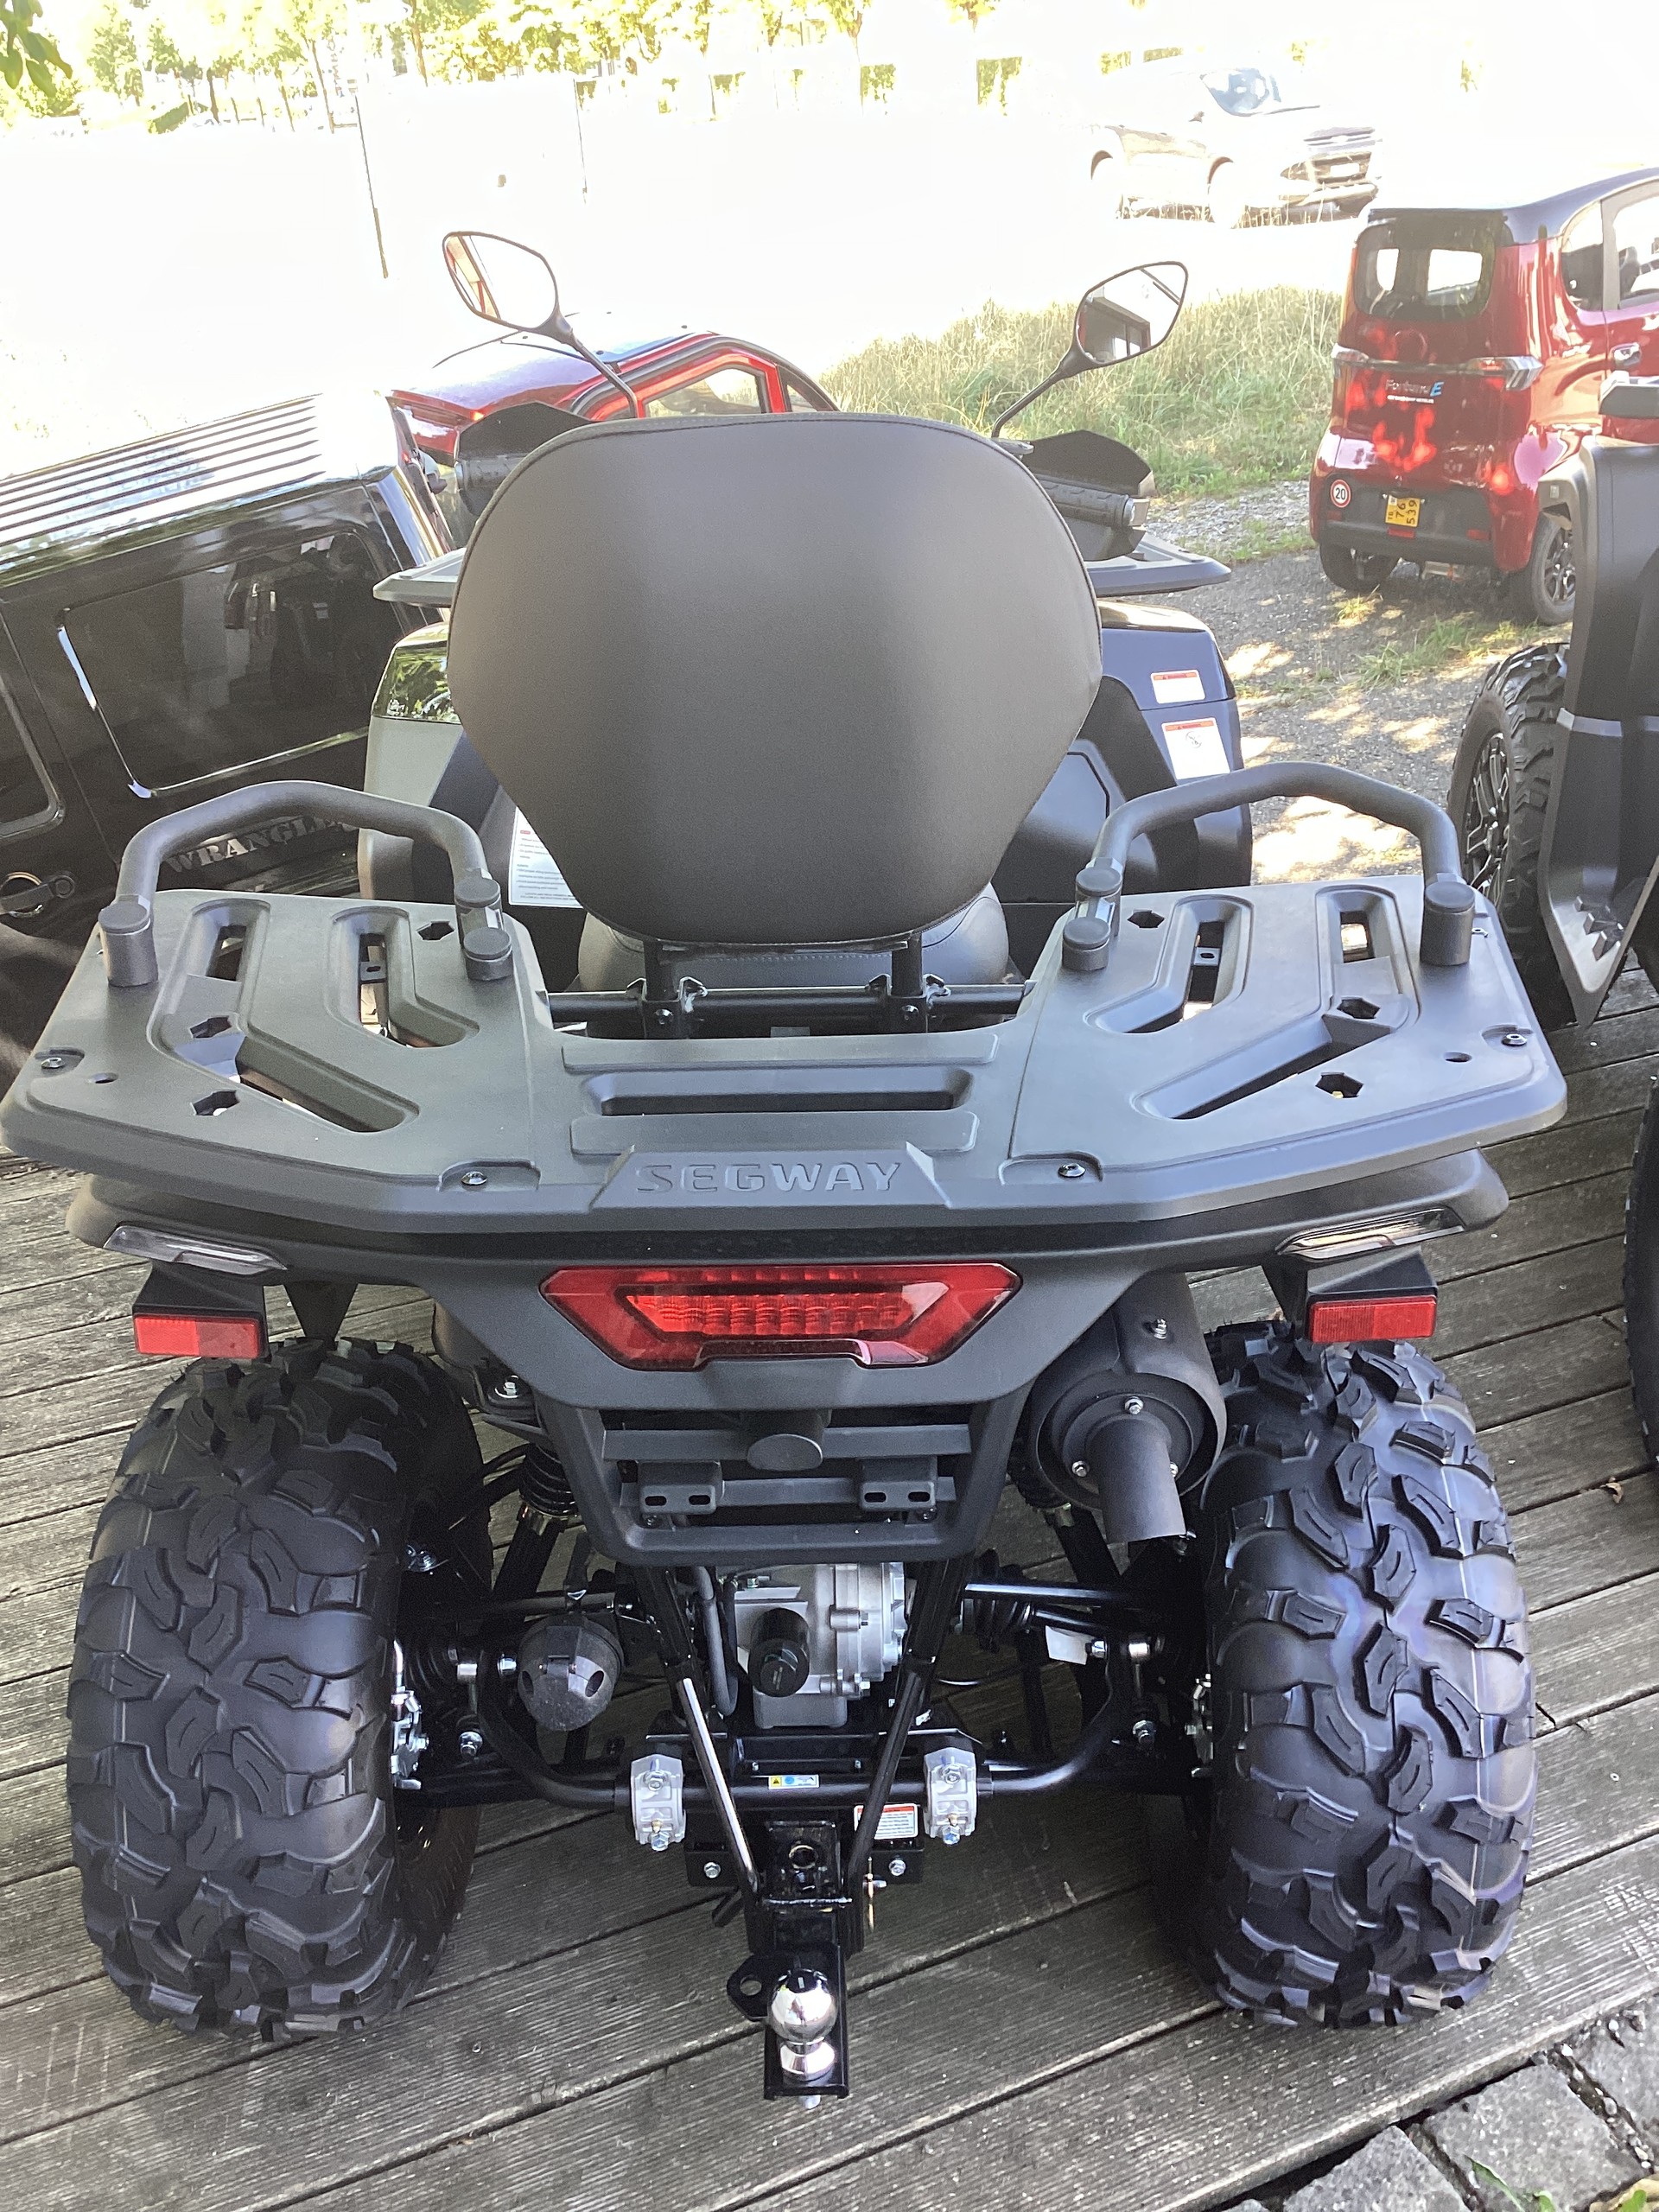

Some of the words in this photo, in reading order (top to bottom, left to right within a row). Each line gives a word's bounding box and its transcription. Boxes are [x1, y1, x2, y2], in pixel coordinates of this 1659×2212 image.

[1335, 487, 1346, 500] 20
[1395, 502, 1406, 518] 76
[1406, 499, 1417, 524] 539
[636, 1162, 901, 1192] SEGWAY
